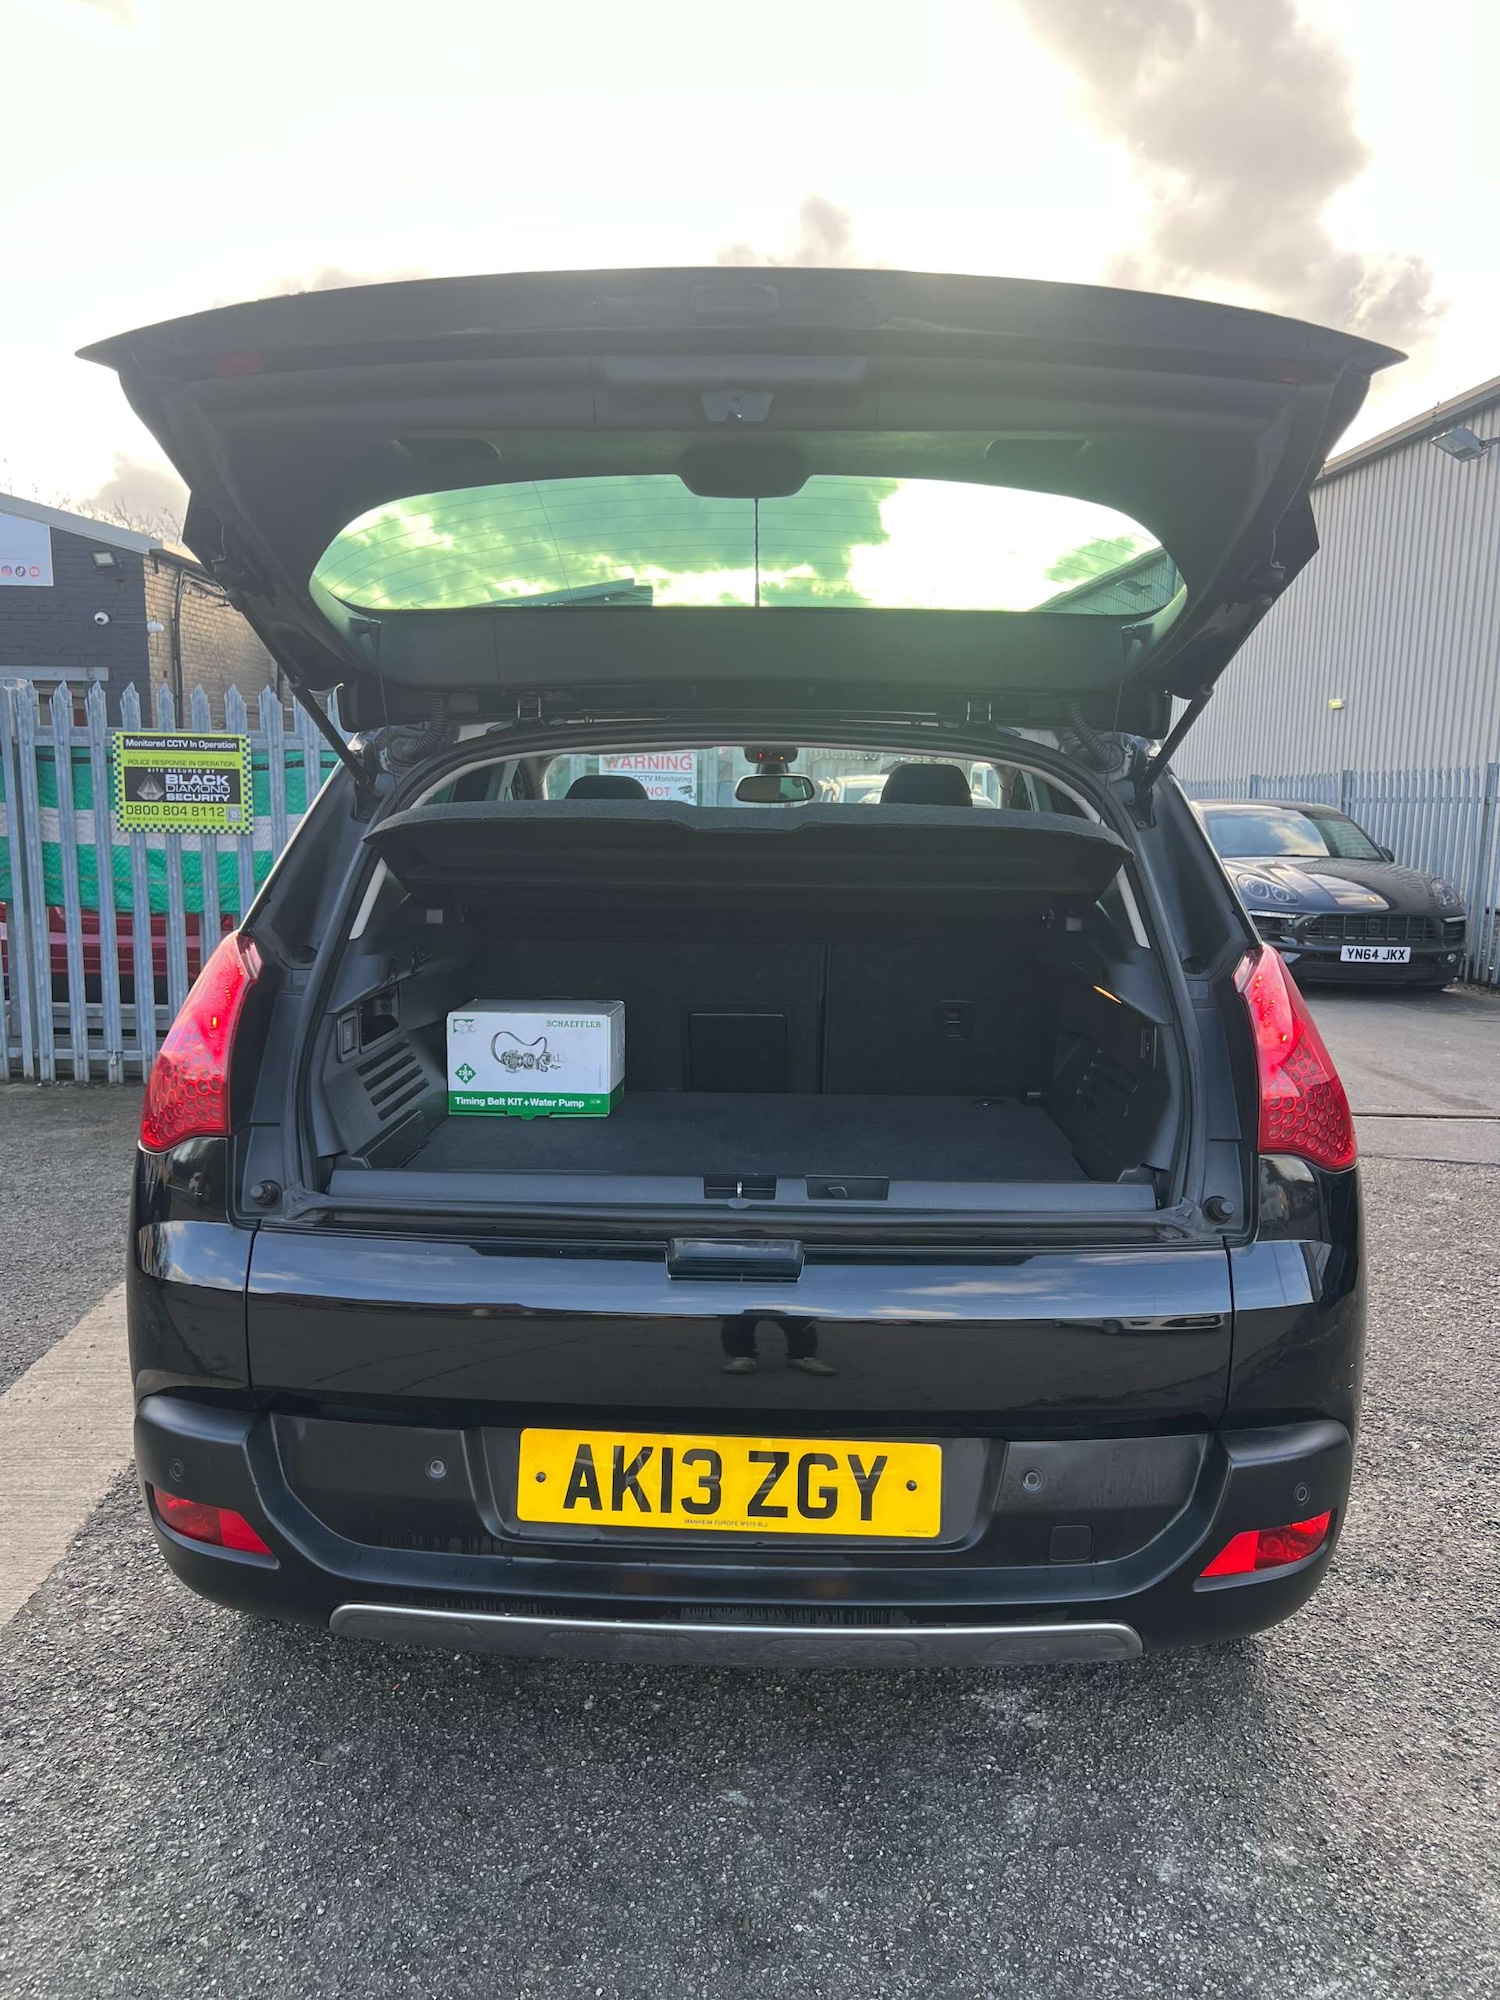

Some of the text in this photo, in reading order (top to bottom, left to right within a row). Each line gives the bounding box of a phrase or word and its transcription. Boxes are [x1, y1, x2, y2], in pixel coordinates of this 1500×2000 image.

[125, 738, 237, 750] Monitored CCTV In Operation
[197, 760, 236, 768] OPERATION
[602, 753, 693, 771] WARNING
[165, 773, 229, 786] BLACK
[654, 776, 692, 784] Monitoring
[165, 784, 231, 794] DIAMOND
[646, 787, 671, 797] NOT
[165, 793, 230, 802] SECURITY
[126, 804, 225, 817] 0800 804 8112
[1347, 948, 1406, 960] YN64 JKX
[546, 1019, 602, 1029] SCHAEFFLER
[454, 1096, 486, 1107] Timing
[487, 1097, 506, 1106] Belt
[558, 1099, 585, 1109] Pump
[563, 1443, 889, 1522] AK13 ZGY
[714, 1519, 739, 1527] EUROPE
